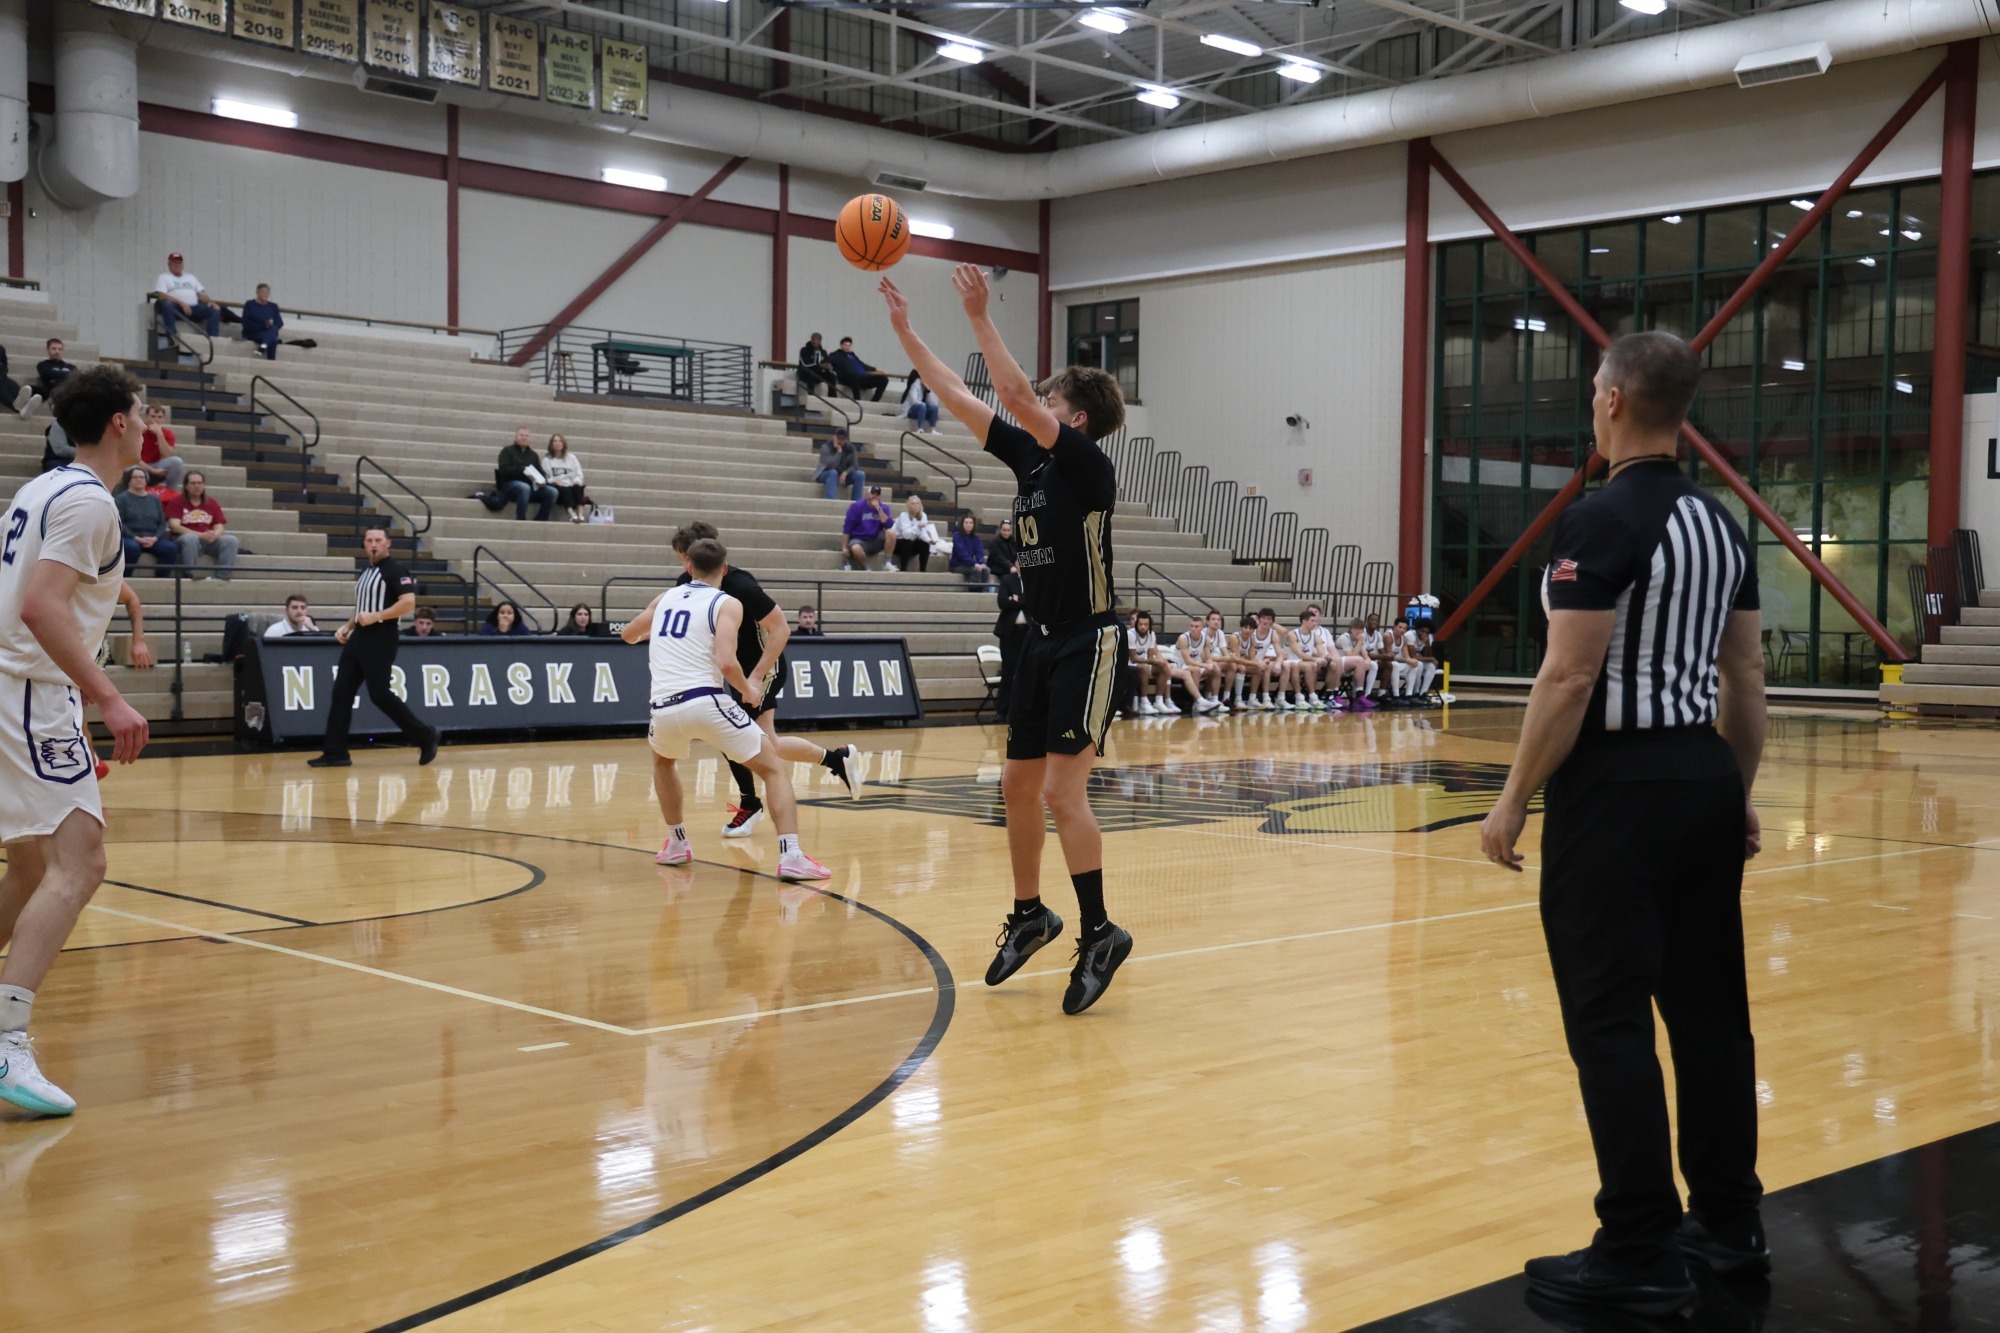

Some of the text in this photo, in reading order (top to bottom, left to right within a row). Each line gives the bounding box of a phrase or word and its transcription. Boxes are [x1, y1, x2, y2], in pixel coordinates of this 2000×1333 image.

[169, 4, 220, 26] 2017-18
[243, 20, 284, 40] 2018
[495, 21, 534, 40] A-R-C
[550, 33, 589, 52] A-R-C
[497, 74, 530, 91] 2021
[2, 506, 28, 567] 2
[1018, 516, 1038, 547] 10
[658, 608, 691, 639] 10
[282, 662, 620, 711] NBRASKA
